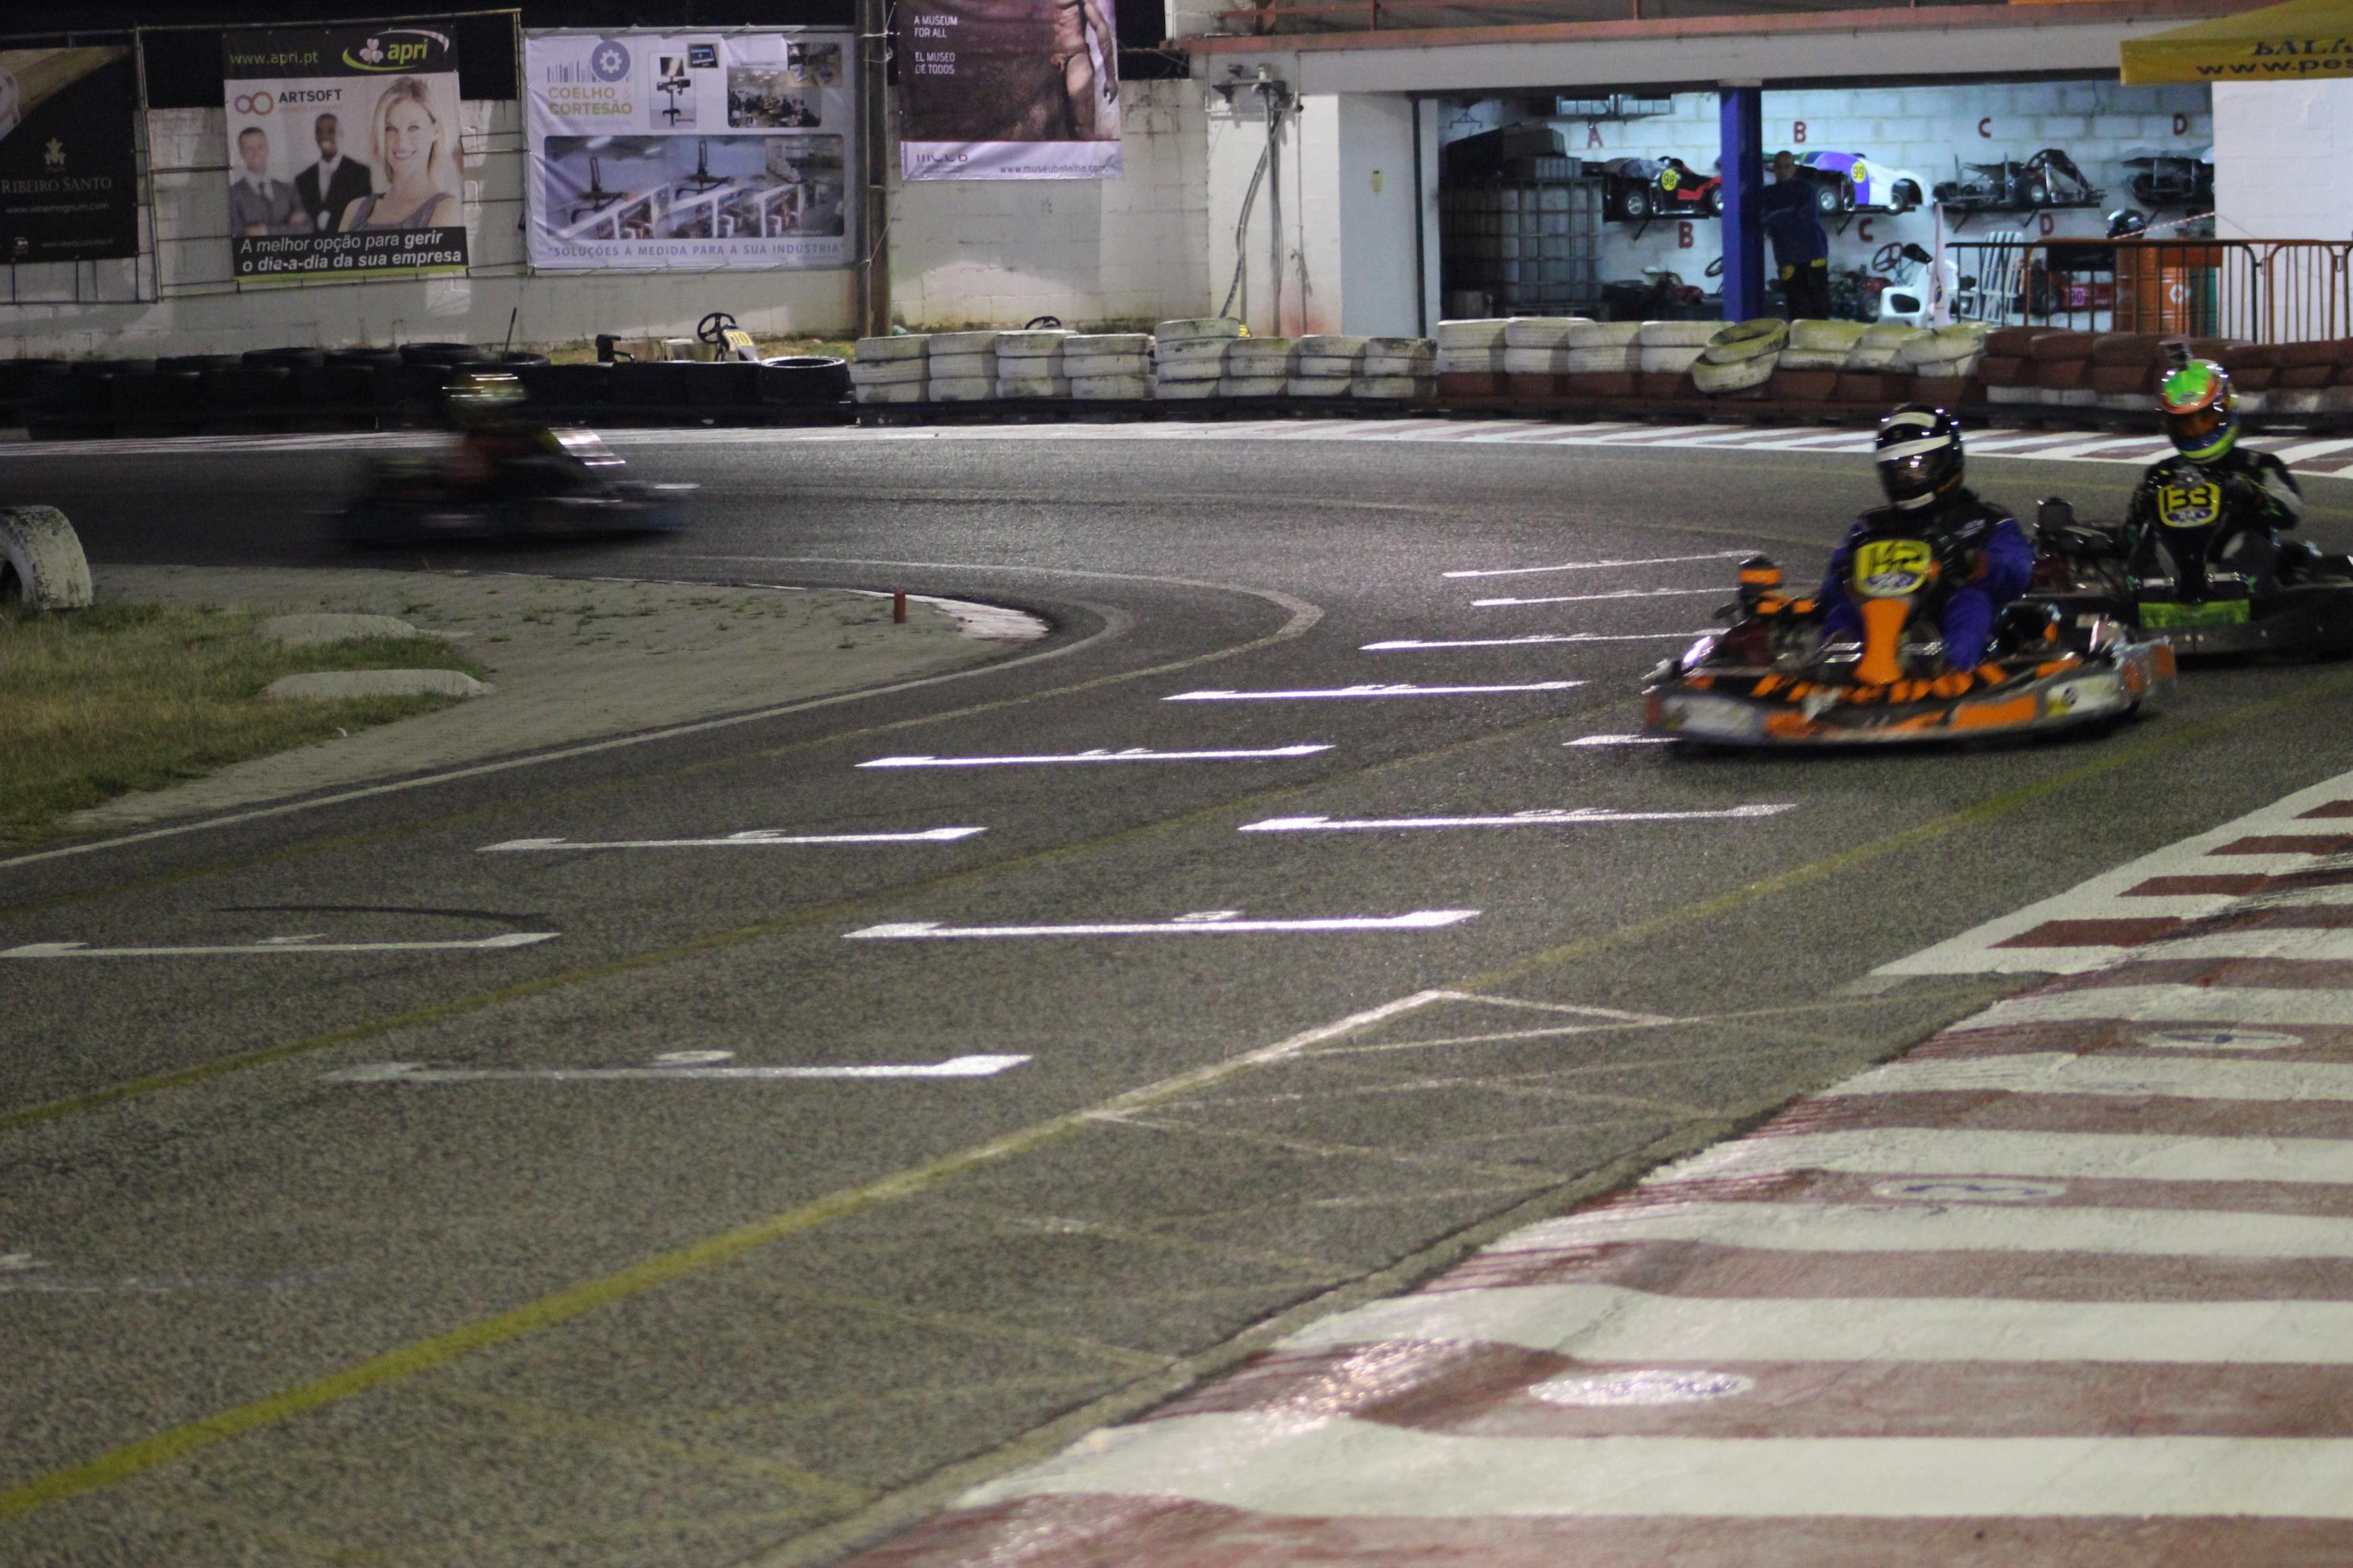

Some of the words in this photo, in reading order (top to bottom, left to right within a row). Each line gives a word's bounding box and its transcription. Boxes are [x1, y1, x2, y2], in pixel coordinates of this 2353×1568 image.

[914, 15, 920, 25] A
[922, 15, 959, 26] MUSEUM
[915, 27, 931, 38] FOR
[932, 27, 947, 38] ALL
[229, 51, 319, 67] www.apri.pt
[387, 39, 429, 64] apri
[915, 51, 925, 62] EL
[927, 51, 956, 62] MUSEO
[915, 64, 926, 74] DE
[928, 64, 955, 74] TODOS
[279, 89, 342, 103] ARTSOFT
[549, 86, 615, 100] COELHO
[549, 99, 633, 115] CORTESÃO
[1793, 121, 1807, 144] B
[1978, 117, 1991, 138] C
[2173, 113, 2188, 135] D
[1587, 124, 1603, 149] A
[1663, 173, 1675, 187] 98
[1853, 166, 1864, 179] 99
[2, 179, 60, 194] RIBEIRO
[63, 176, 113, 191] SANTO
[1858, 217, 1874, 243] C
[2040, 213, 2054, 235] D
[241, 238, 252, 253] A
[256, 238, 309, 253] melhor
[314, 234, 361, 254] opção
[365, 234, 399, 251] para
[405, 229, 443, 250] gerir
[1677, 221, 1694, 249] B
[638, 245, 688, 256] MEDIDA
[692, 245, 725, 256] PARA
[729, 245, 738, 255] A
[743, 244, 767, 255] SUA
[242, 261, 253, 272] o
[258, 255, 328, 272] dia-a-dia
[333, 253, 353, 268] da
[358, 254, 387, 266] sua
[392, 250, 462, 267] empresa
